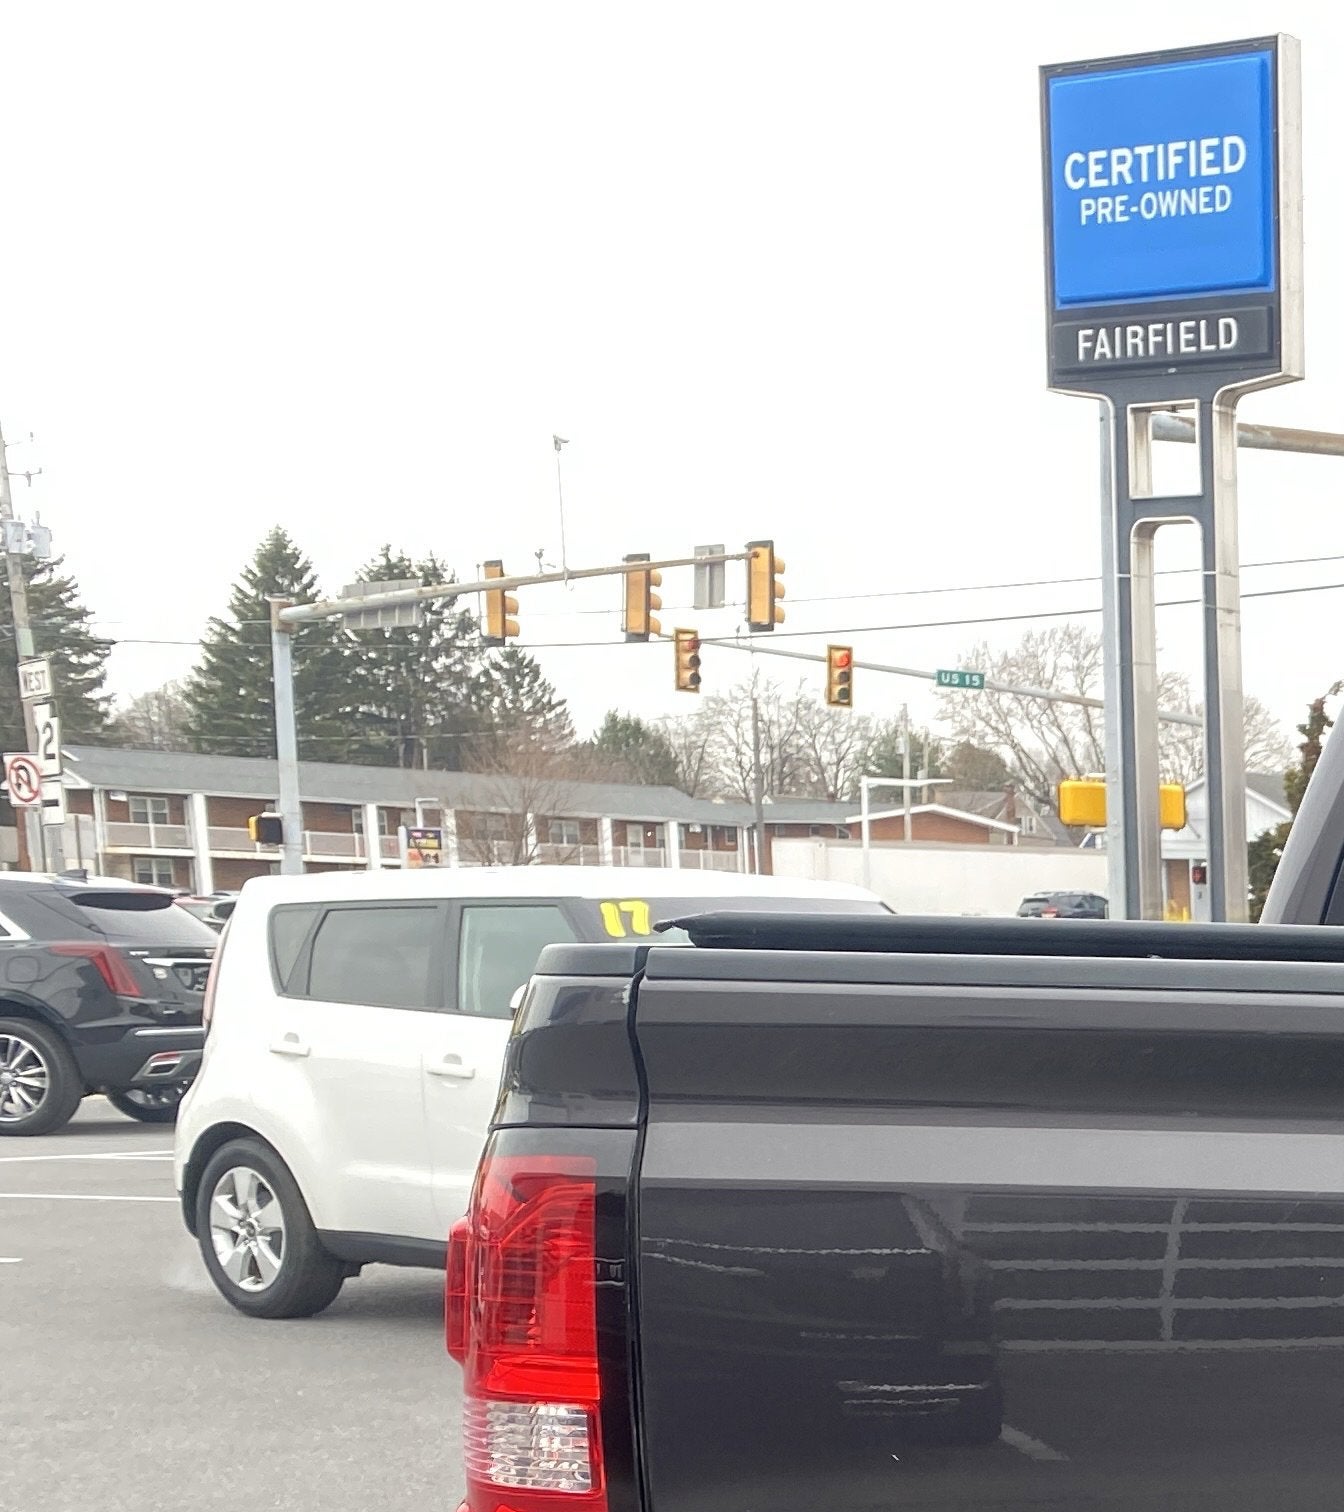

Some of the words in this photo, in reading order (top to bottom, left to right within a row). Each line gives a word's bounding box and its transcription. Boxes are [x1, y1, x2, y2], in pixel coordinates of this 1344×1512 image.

[1064, 135, 1246, 190] CERTIFIED
[1080, 185, 1232, 225] PRE-OWNED
[1077, 317, 1238, 361] FAIRFIELD
[941, 672, 959, 684] US
[965, 674, 980, 686] 15
[600, 901, 650, 937] 17
